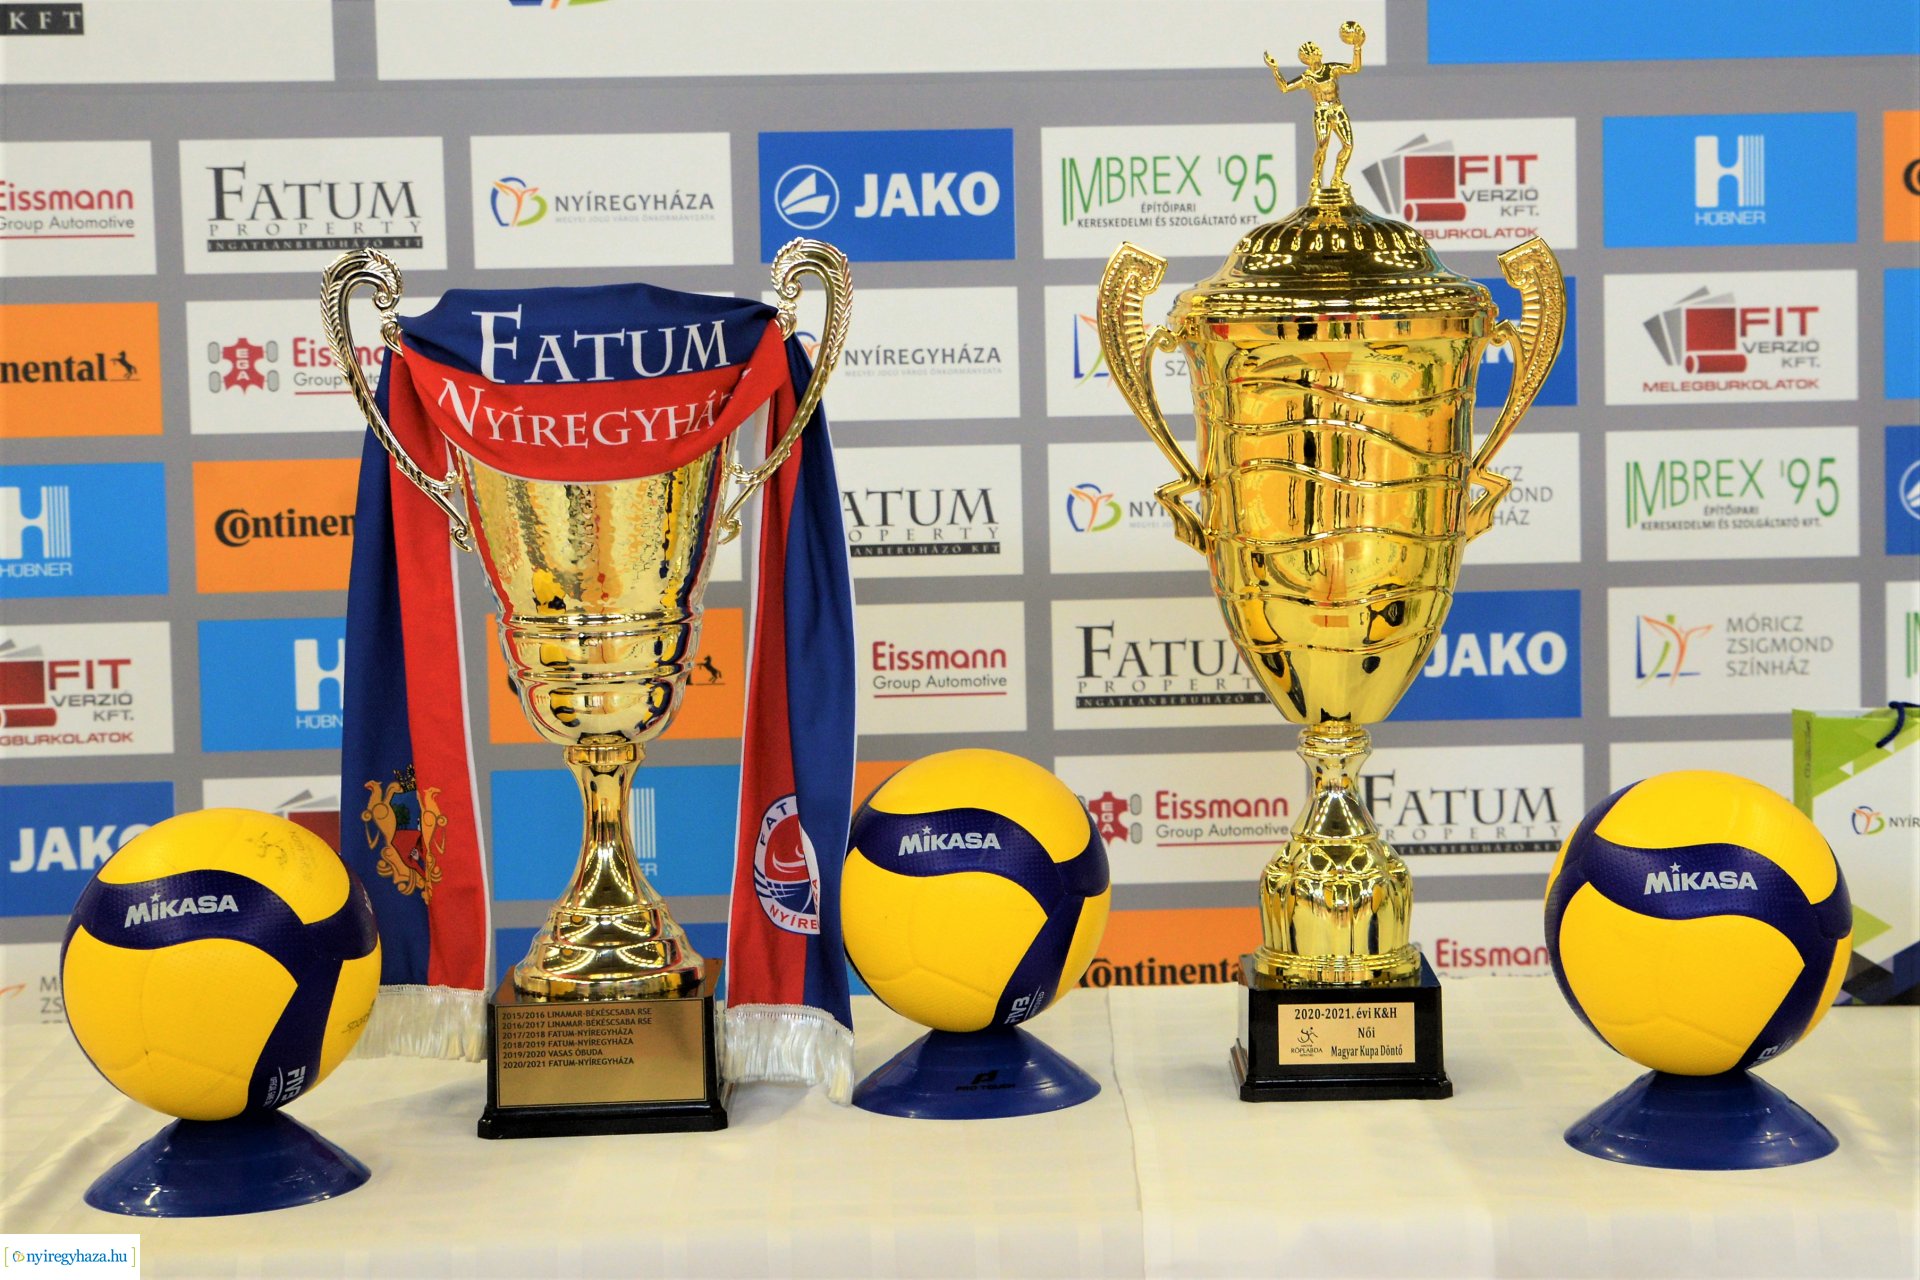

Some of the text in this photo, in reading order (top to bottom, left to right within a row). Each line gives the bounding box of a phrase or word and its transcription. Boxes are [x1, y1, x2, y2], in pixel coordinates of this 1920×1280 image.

[9, 11, 82, 30] KFT
[1459, 154, 1538, 185] FIT
[205, 161, 422, 221] FATUM
[854, 170, 1001, 219] JAKO
[1062, 155, 1202, 226] IMBREX
[1460, 187, 1539, 202] VERZIÓ
[555, 189, 715, 212] NYÍREGYHÁZA
[1141, 200, 1196, 213] ÉPÍTŐIPARI
[1500, 205, 1540, 217] KFT.
[49, 214, 135, 230] Automotive
[209, 221, 423, 237] PROPERTY
[1077, 214, 1260, 228] KERESKEDELMI ÉS SZOLGÁLTATÓ KFT.
[1422, 227, 1538, 239] BURKOLATOK
[393, 237, 423, 248] KFT
[1740, 306, 1819, 337] FIT
[471, 303, 731, 384] FATUM
[1742, 339, 1820, 354] VERZIÓ
[844, 344, 1001, 366] NYÍREGYHÁZA
[1781, 357, 1820, 368] KFT.
[293, 372, 343, 389] Group
[1642, 379, 1820, 393] MELEGBURKOLATOK
[438, 377, 733, 450] NYÍREGYHÁ
[1626, 459, 1764, 528] IMBREX
[842, 488, 999, 527] ATUM
[1703, 503, 1759, 517] ÉPÍTŐIPARI
[215, 507, 356, 548] Continen
[1641, 516, 1822, 531] KERESKEDELMI ÉS SZOLGÁLTATÓ KFT.
[848, 526, 999, 543] OPERTY
[972, 543, 1000, 554] KFT
[1726, 613, 1803, 633] MÓRICZ
[1424, 630, 1567, 678] JAKO
[1726, 636, 1834, 655] ZSIGMOND
[872, 641, 1007, 671] Eissmann
[48, 658, 131, 690] FIT
[1726, 655, 1810, 677] SZÍNHÁZ
[873, 673, 1007, 692] Group Automotive
[1078, 678, 1255, 693] PROPERT
[51, 691, 133, 707] VERZIÓ
[93, 709, 134, 721] KFT.
[1155, 790, 1289, 820] Eissmann
[760, 802, 788, 846] FAT
[1156, 822, 1289, 840] Group Automotive
[1385, 824, 1563, 841] ROPERTY
[1436, 938, 1550, 968] Eissman
[502, 1011, 545, 1020] 2015/2016
[547, 1009, 635, 1019] LINAMAR-BÉKÉSCSABA
[1294, 1007, 1397, 1020] 2020-2021. évi K&H
[502, 1022, 545, 1030] 2016/2017
[547, 1019, 635, 1028] LINAMAR-BÉKÉSCSABA
[1358, 1027, 1375, 1038] Női
[503, 1028, 633, 1040] 2017/2018 FATUM-NYÍREGYHÁZA
[503, 1038, 633, 1050] 2018/2019 FATUM-NYÍREGYHÁZA
[1331, 1044, 1403, 1059] Magyar Kupa Döntő
[503, 1048, 603, 1059] 2019/2020 VASAS ÓBUDA
[503, 1057, 634, 1069] 2020/2021 FATUM-NYÍREGYHÁZA
